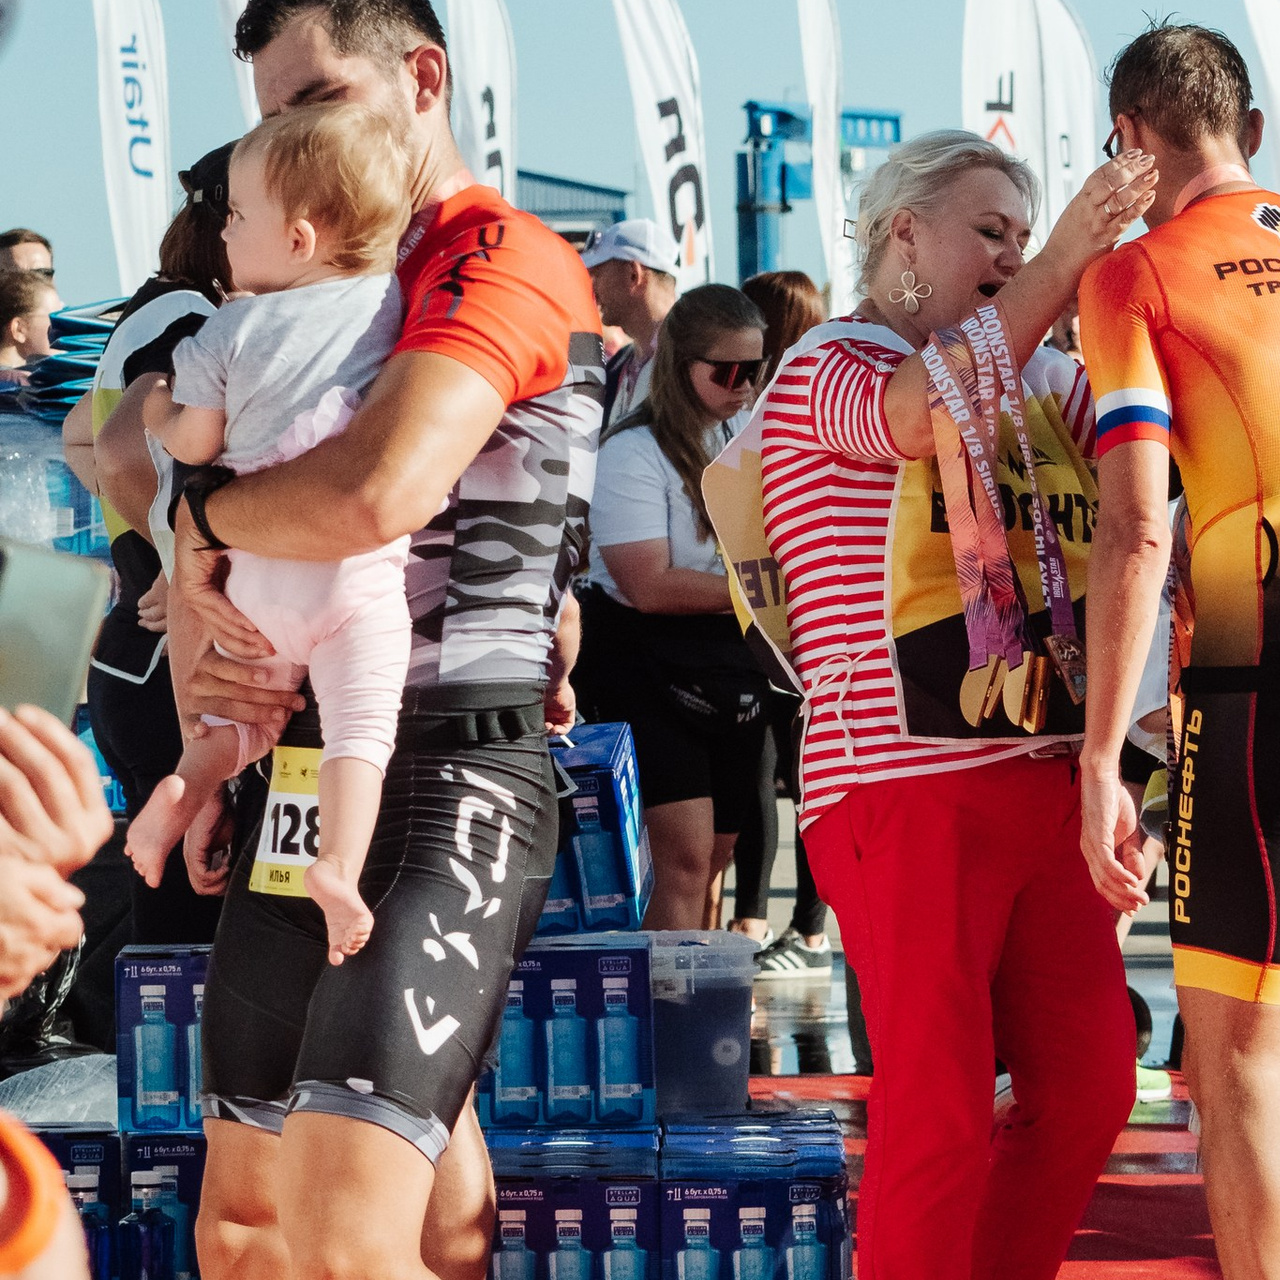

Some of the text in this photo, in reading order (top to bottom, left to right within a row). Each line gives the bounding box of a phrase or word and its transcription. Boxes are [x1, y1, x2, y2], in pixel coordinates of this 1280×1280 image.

[960, 316, 996, 401] IRONSTAR
[920, 342, 971, 424] IRONSTAR
[961, 424, 984, 458] 1/8
[977, 304, 1017, 392] IRONSTAR
[1009, 396, 1025, 428] 1/8
[1032, 498, 1046, 556] SOCHI
[1174, 708, 1203, 924] РОСНЕФТЬ
[269, 870, 291, 884] ИЛЬЯ
[163, 965, 176, 973] 0,75
[523, 1189, 537, 1197] 0,75
[708, 1188, 721, 1196] 0,75
